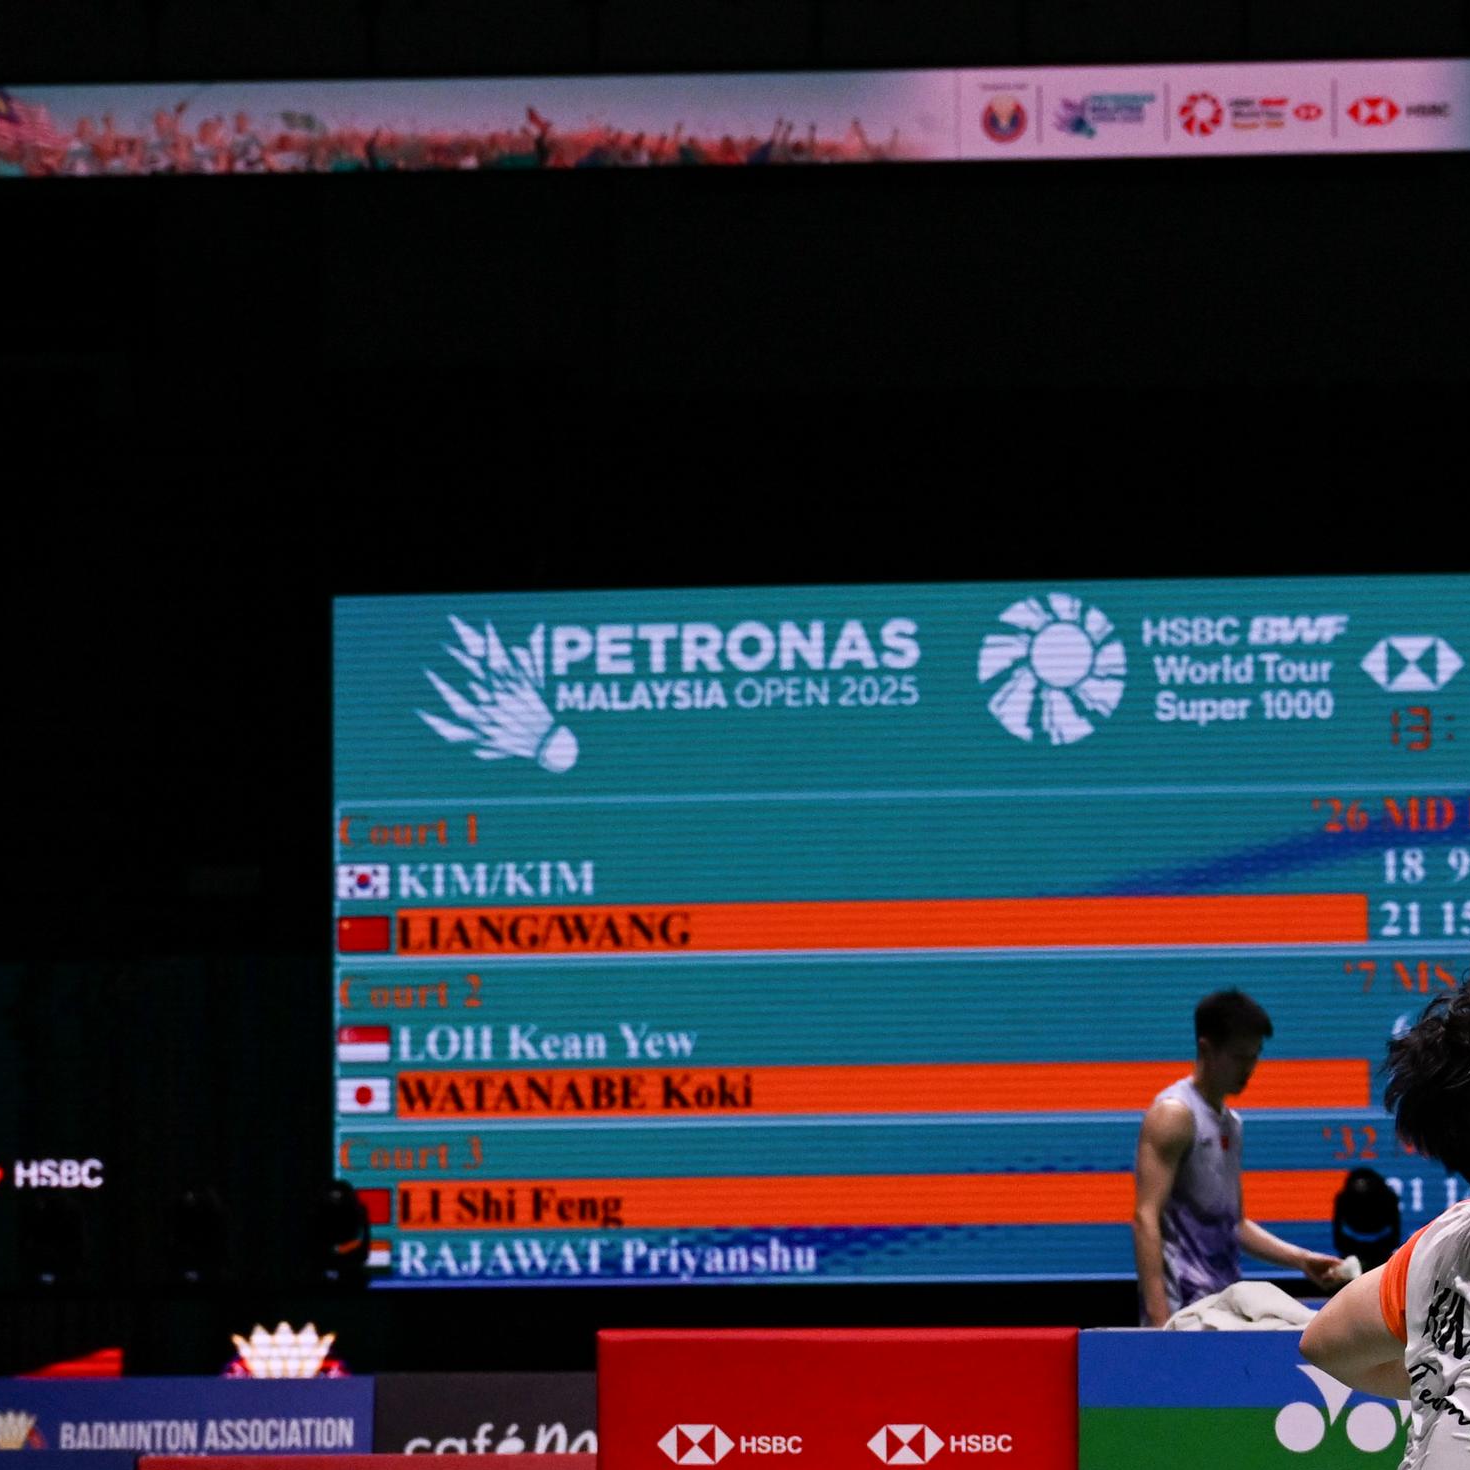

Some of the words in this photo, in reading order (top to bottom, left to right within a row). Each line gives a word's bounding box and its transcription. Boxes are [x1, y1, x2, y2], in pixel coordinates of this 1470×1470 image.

[552, 618, 921, 676] PETRONAS
[1142, 617, 1240, 647] HSBC
[1248, 614, 1349, 645] BWF
[1153, 655, 1253, 685] World
[1258, 653, 1333, 683] Tour
[556, 680, 728, 712] MALAYSIA
[734, 678, 829, 709] OPEN
[838, 675, 920, 707] 2025
[1154, 691, 1250, 726] Super
[1262, 690, 1334, 720] 1000
[339, 816, 449, 846] Court
[1384, 796, 1455, 832] MD
[397, 862, 594, 898] KIM/KIM
[1384, 848, 1425, 884] 18
[399, 911, 691, 951] LIANG/WANG
[1380, 901, 1421, 936] 21
[338, 976, 449, 1008] Court
[463, 974, 482, 1007] 2
[398, 1026, 493, 1063] LOH
[509, 1024, 606, 1060] Kean
[619, 1023, 697, 1059] Yew
[398, 1074, 646, 1113] WATANABE
[661, 1073, 753, 1111] Koki
[339, 1139, 450, 1171] Court
[463, 1136, 482, 1169] 3
[15, 1159, 104, 1189] HSBC
[399, 1190, 443, 1226] LI
[456, 1188, 517, 1223] Shi
[531, 1186, 623, 1229] Feng
[398, 1239, 610, 1277] RAJAWAT
[622, 1238, 817, 1280] Priyanshu
[59, 1420, 198, 1450] BADMINTON
[203, 1417, 354, 1448] ASSOCIATION
[740, 1435, 802, 1454] HSBC
[950, 1434, 1012, 1453] HSBC
